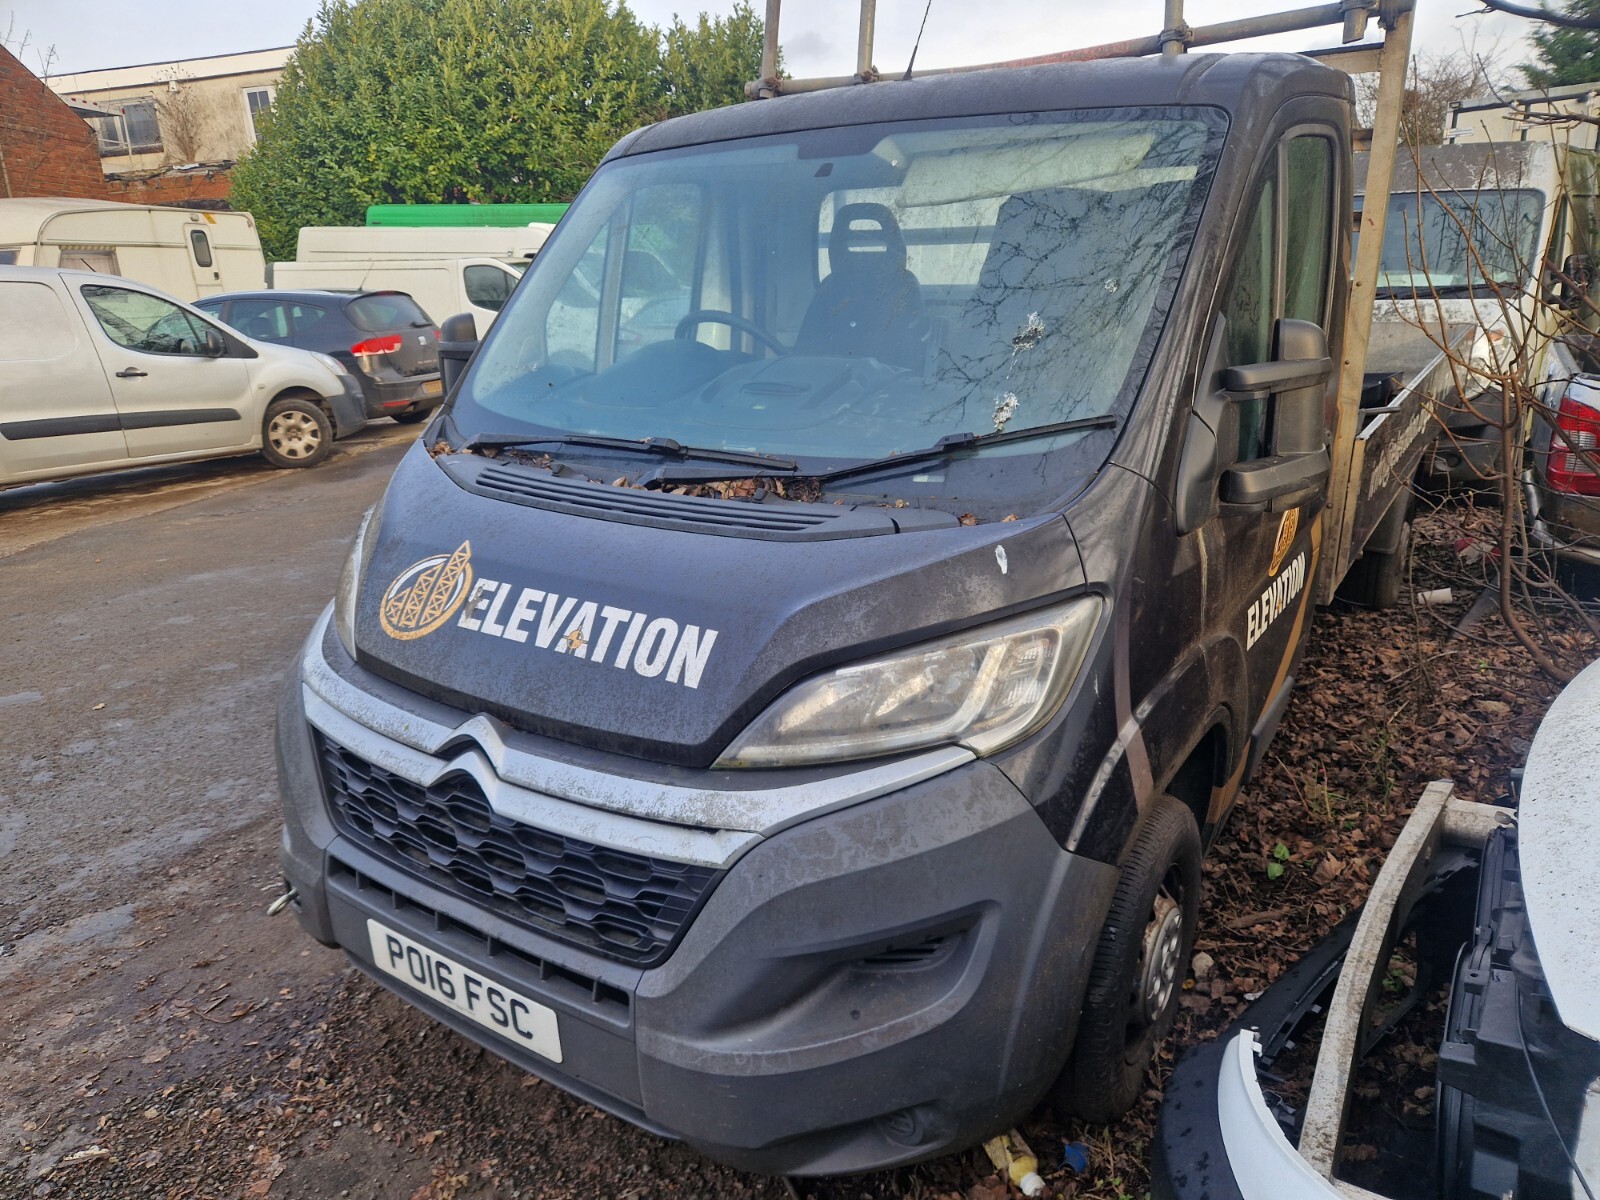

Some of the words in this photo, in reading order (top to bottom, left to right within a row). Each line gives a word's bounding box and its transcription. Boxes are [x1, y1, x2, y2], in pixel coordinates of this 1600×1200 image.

[457, 577, 719, 689] ELEVATION
[1246, 551, 1306, 651] ELEVATION
[386, 934, 456, 1001] PO16
[463, 973, 533, 1040] FSC
